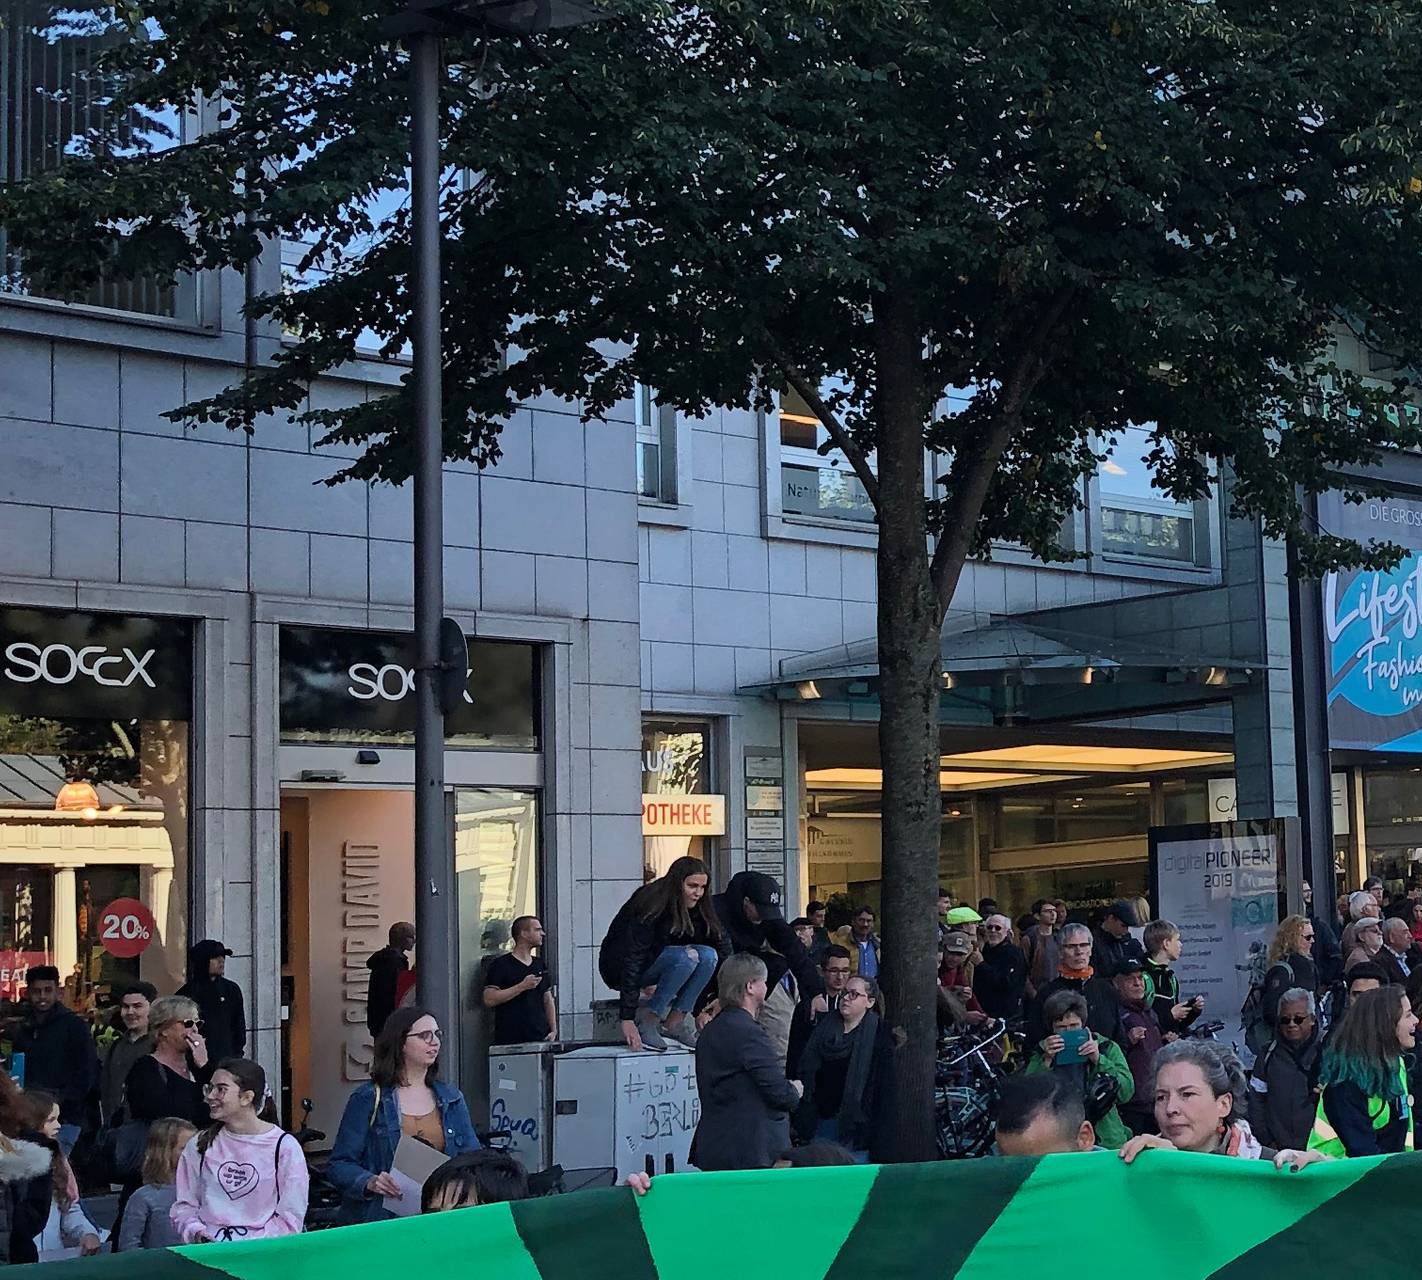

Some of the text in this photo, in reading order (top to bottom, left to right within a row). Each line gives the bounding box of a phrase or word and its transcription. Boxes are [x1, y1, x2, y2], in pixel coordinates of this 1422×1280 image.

[1369, 504, 1389, 522] DIE
[1205, 849, 1271, 869] PIONEER
[1203, 873, 1233, 889] 2019
[102, 913, 150, 941] 20%
